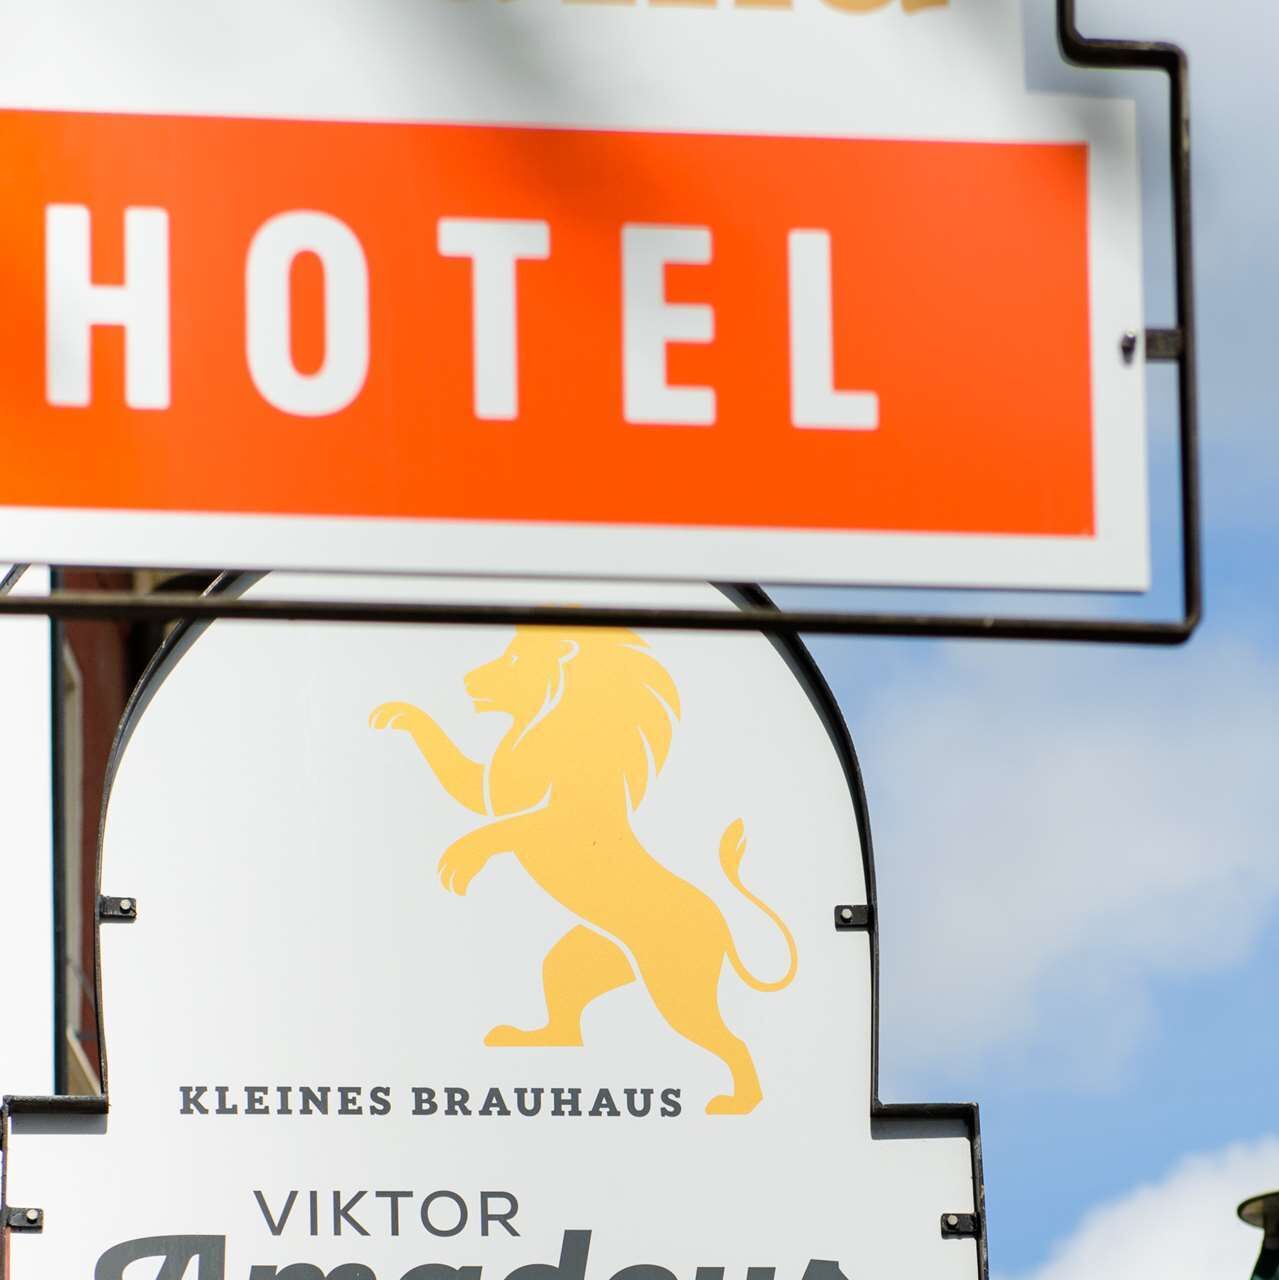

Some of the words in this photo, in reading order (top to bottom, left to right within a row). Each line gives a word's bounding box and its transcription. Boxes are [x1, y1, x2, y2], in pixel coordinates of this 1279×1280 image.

[45, 204, 879, 431] HOTEL
[180, 1087, 391, 1116] KLEINES
[412, 1088, 681, 1117] BRAUHAUS
[254, 1191, 521, 1237] VIKTOR
